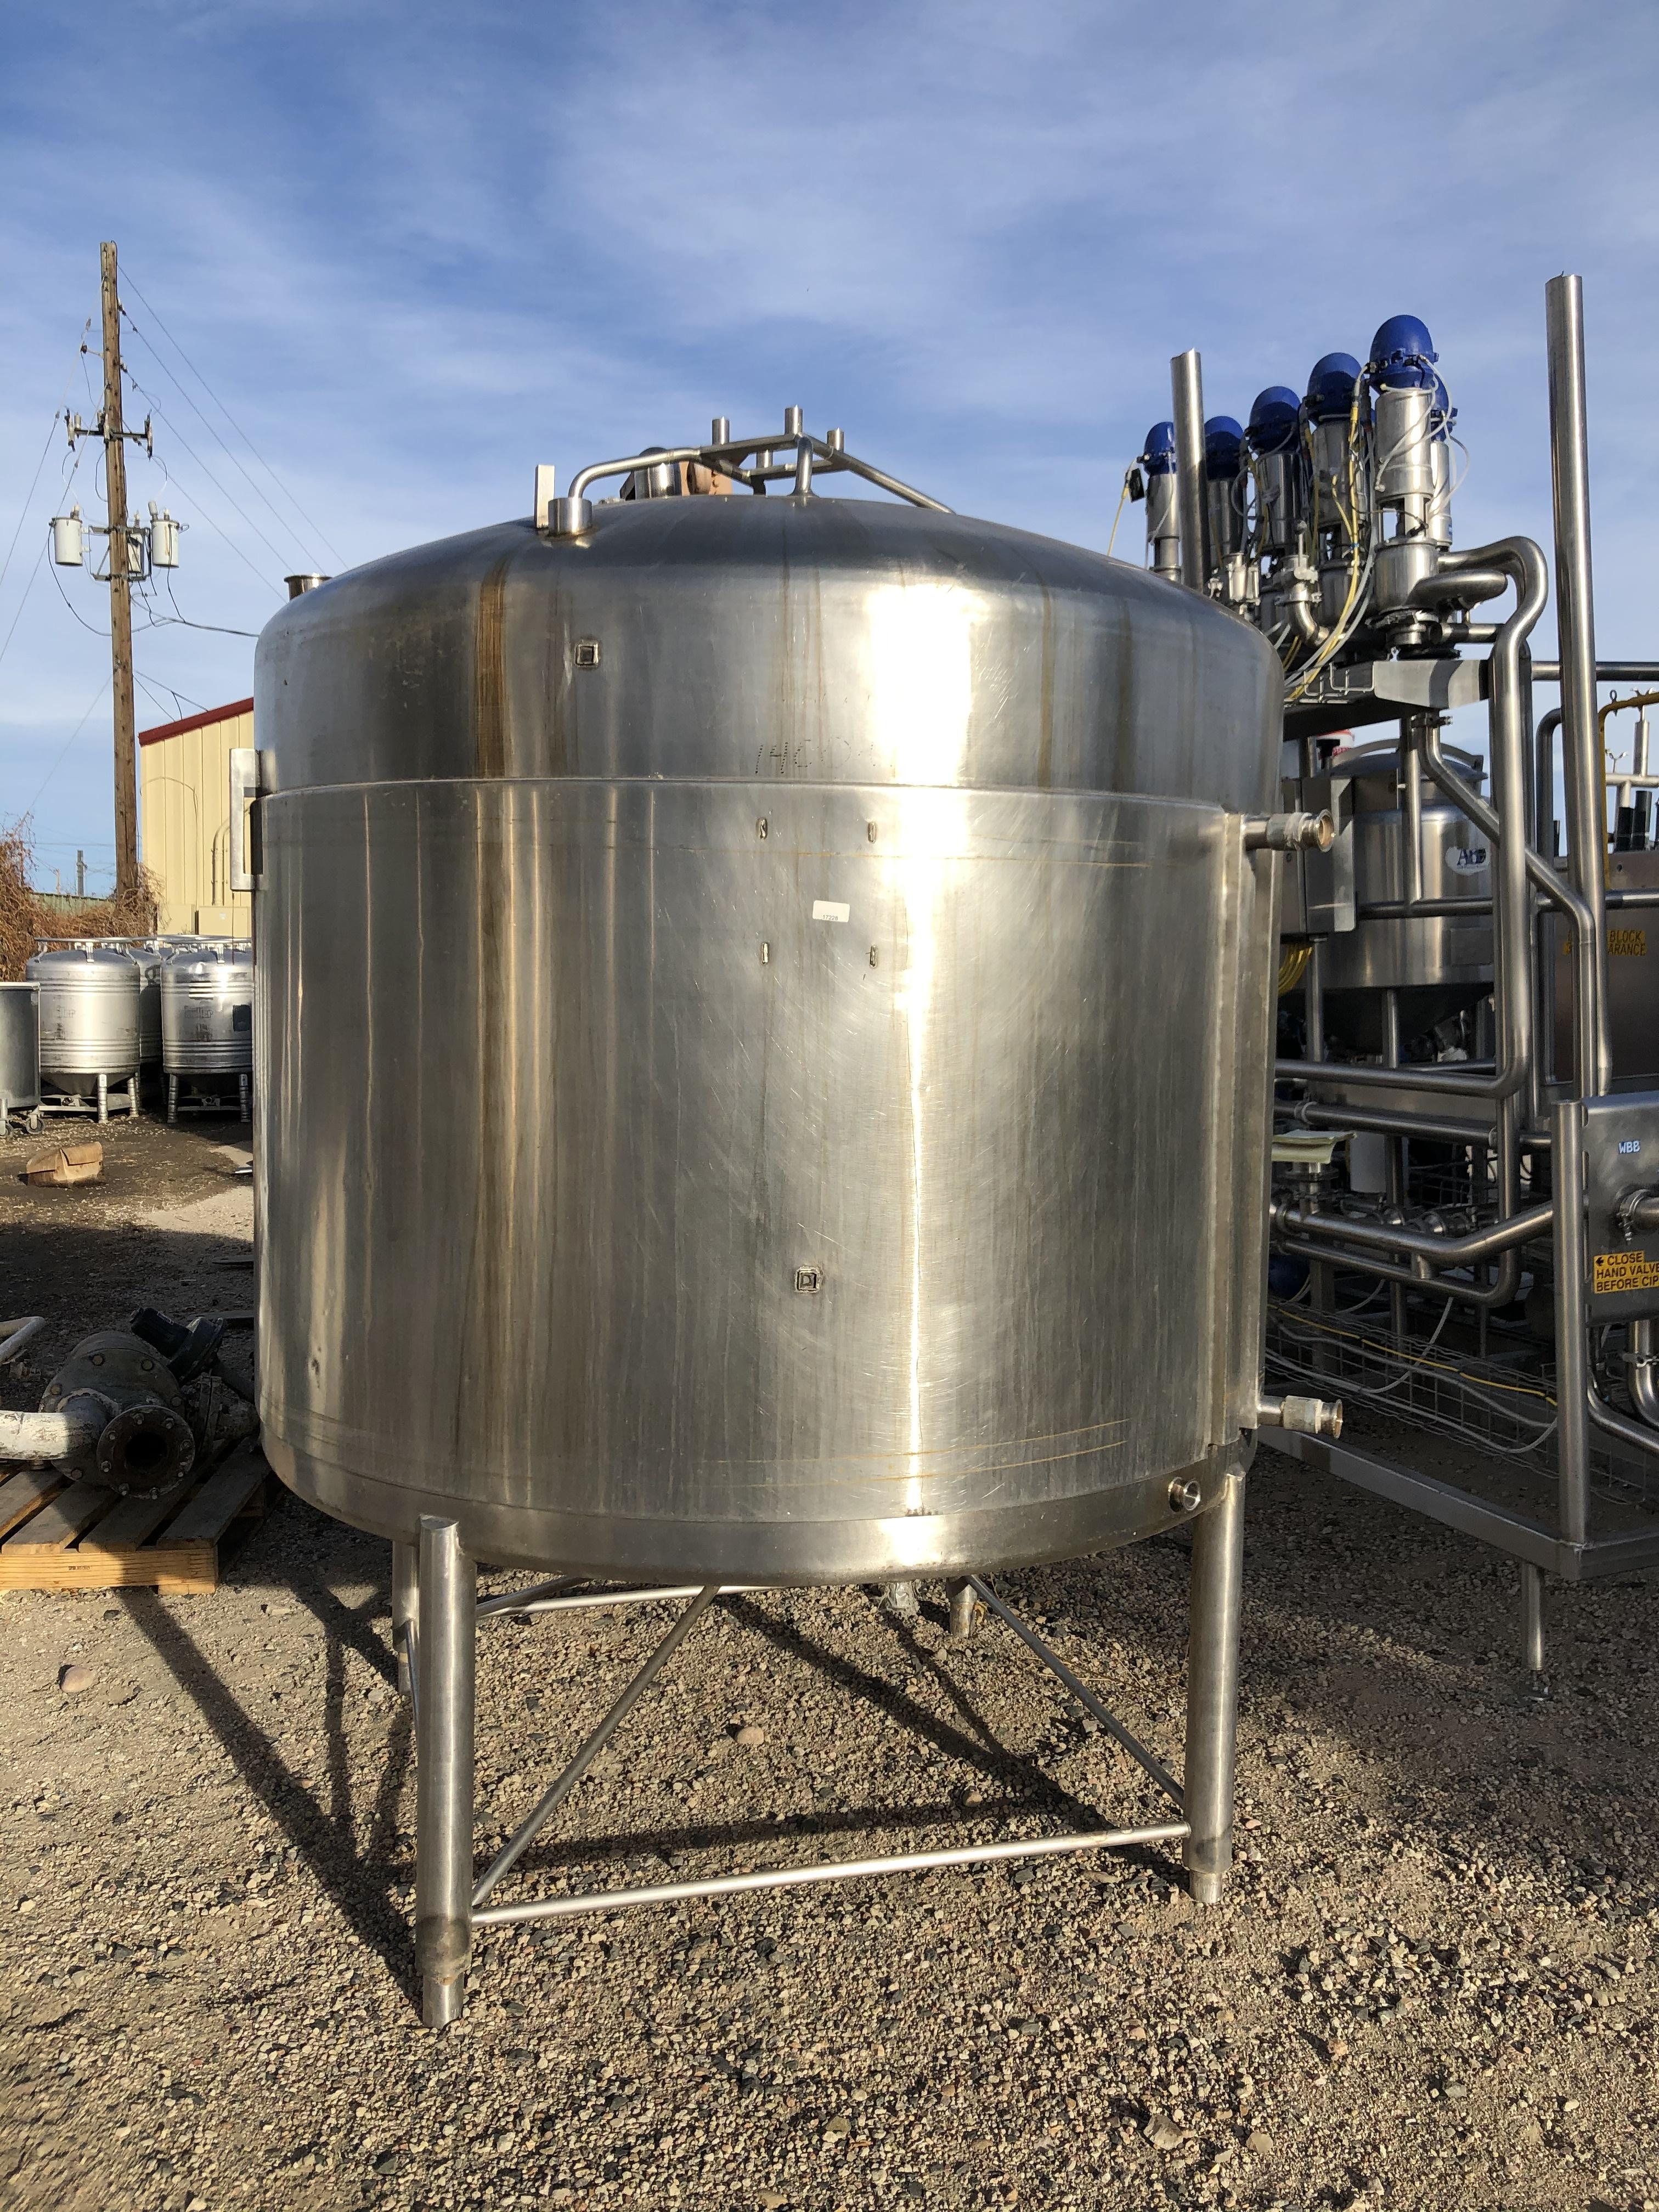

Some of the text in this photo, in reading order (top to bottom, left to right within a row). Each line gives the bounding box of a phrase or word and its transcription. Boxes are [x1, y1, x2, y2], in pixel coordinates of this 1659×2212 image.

[1610, 930, 1641, 943] BLOCK
[1608, 943, 1646, 956] ARANCE
[1619, 1141, 1640, 1154] WBB
[1607, 1252, 1642, 1266] CLOSE
[1596, 1266, 1627, 1279] HAND
[1596, 1276, 1658, 1292] BEFORE CIP
